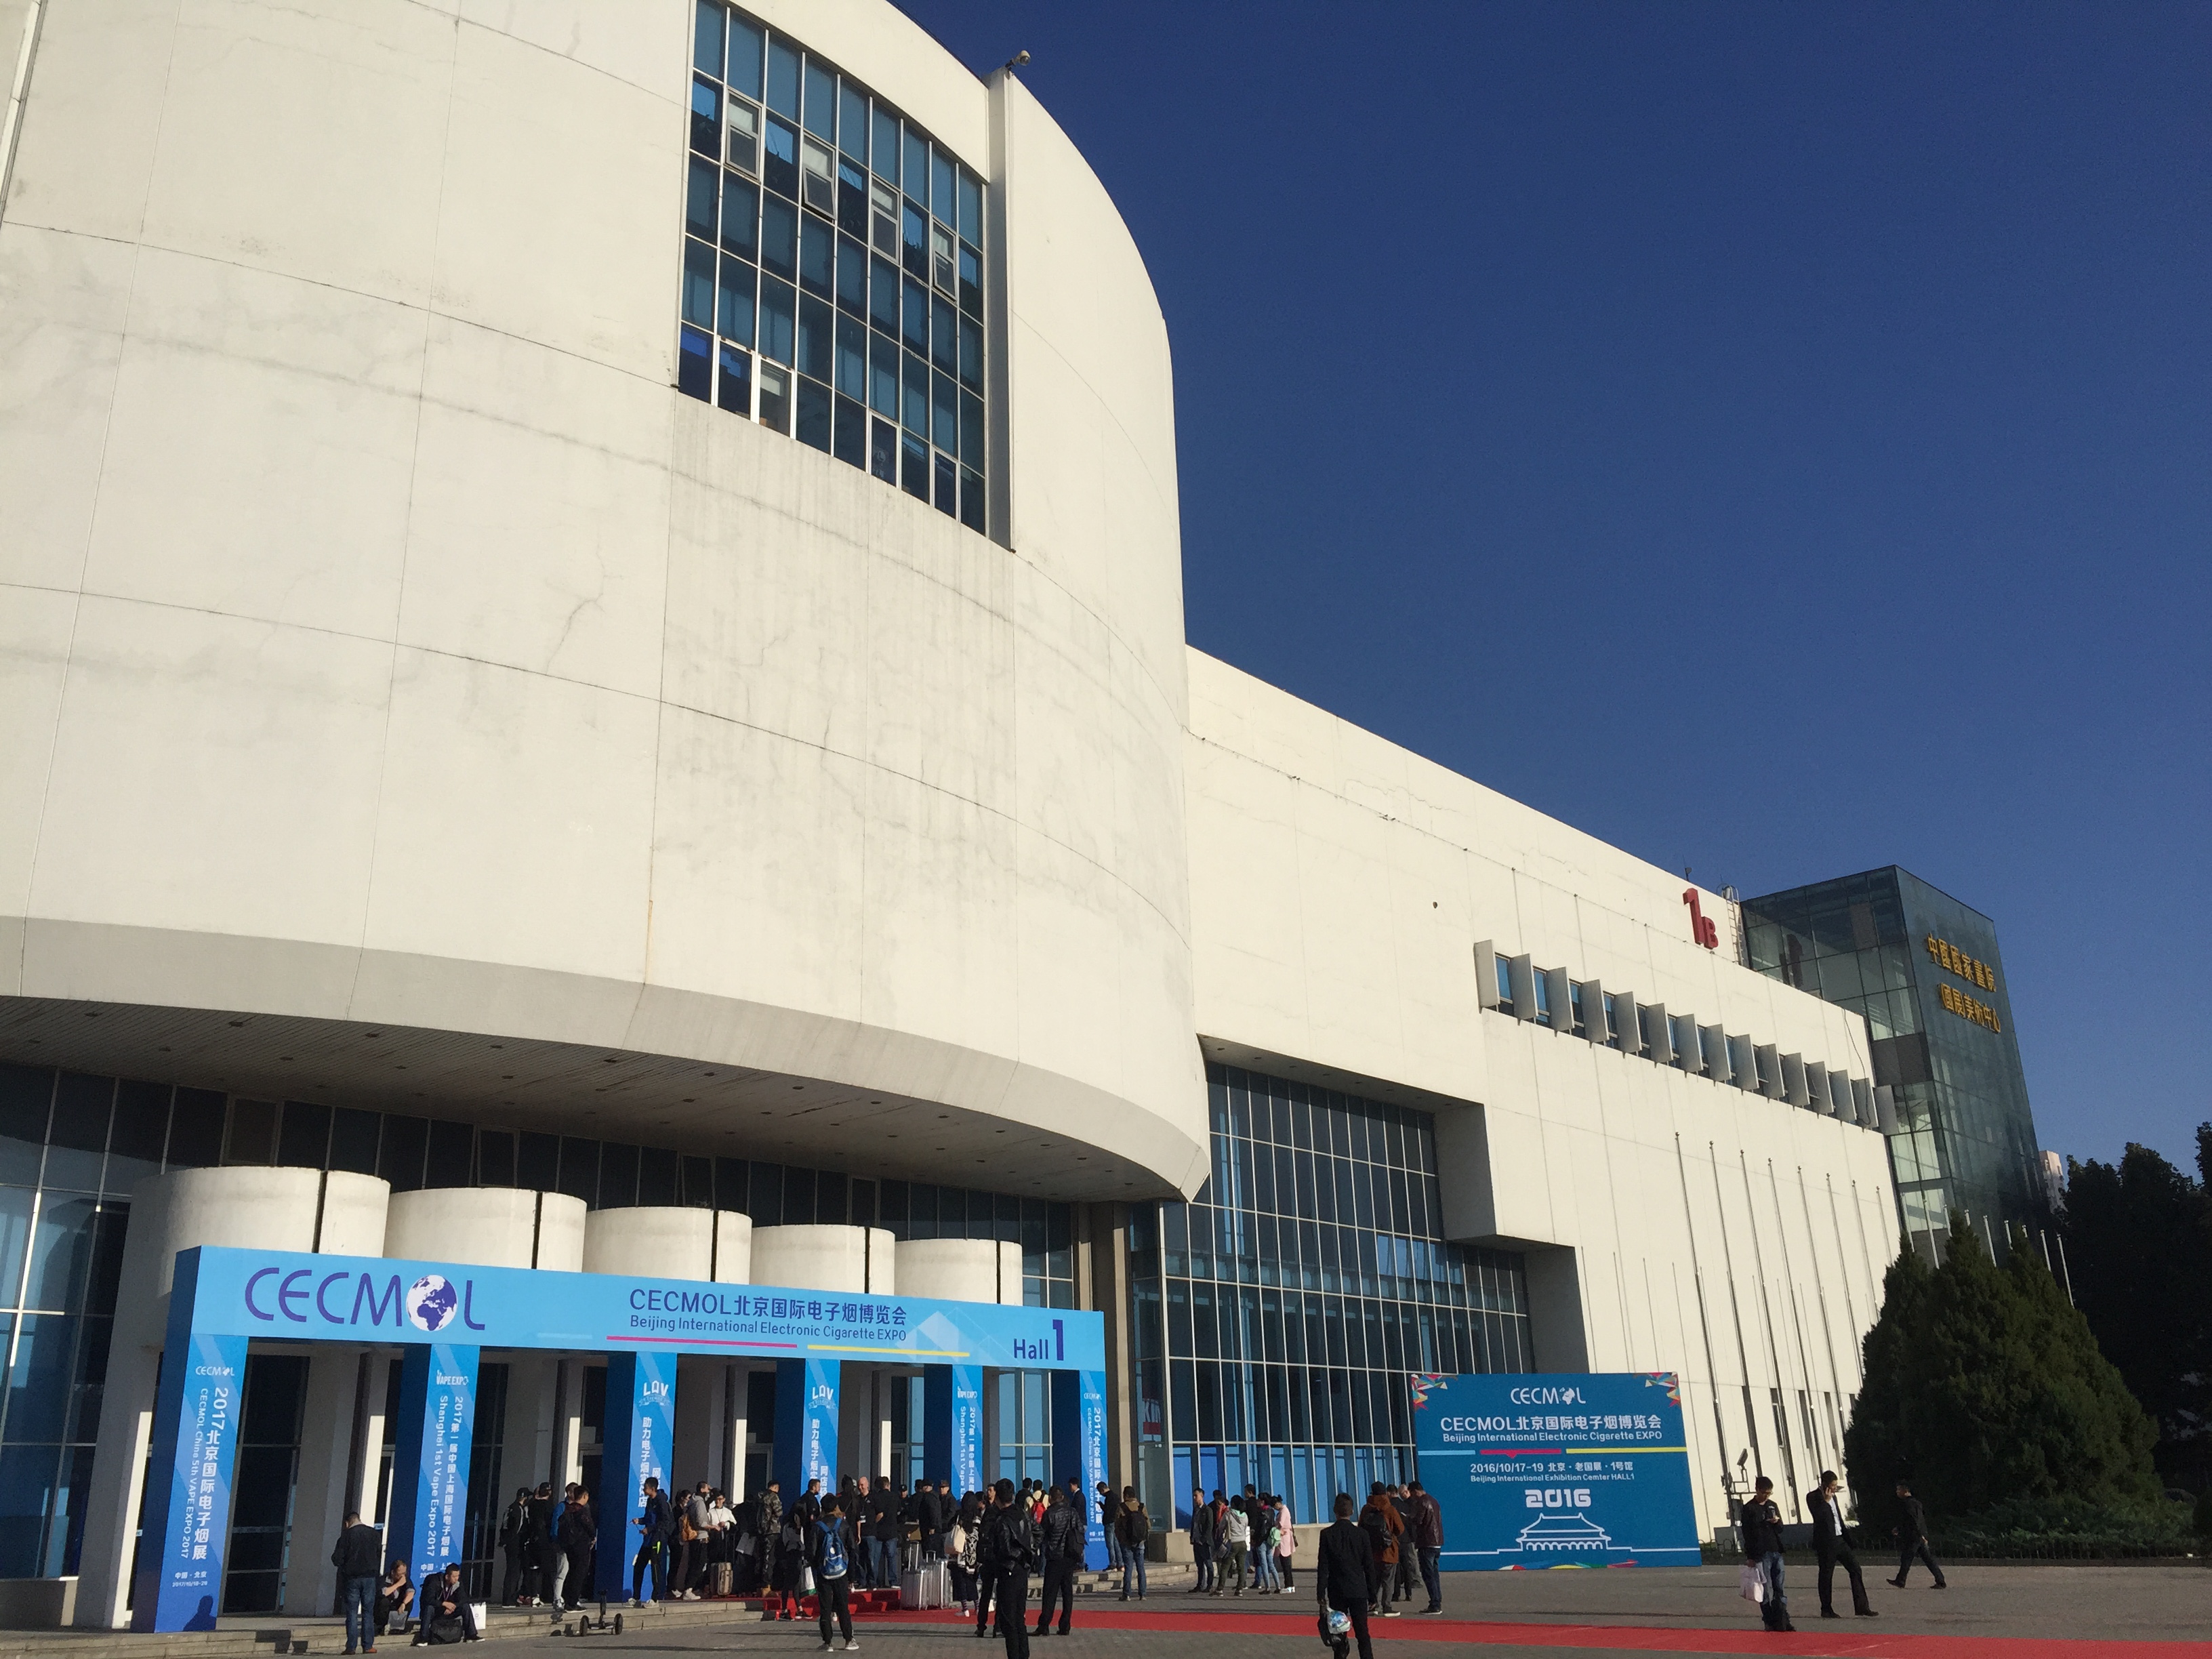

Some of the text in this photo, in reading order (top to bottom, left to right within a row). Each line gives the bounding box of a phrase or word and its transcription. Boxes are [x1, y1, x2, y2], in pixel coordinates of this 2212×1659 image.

[245, 1267, 485, 1332] CECMOL
[630, 1315, 907, 1341] Beijing International Electronic Cigarette EXPO
[1014, 1319, 1064, 1361] Hall 1
[1511, 1387, 1586, 1405] CECMOL
[1443, 1431, 1662, 1443] Beijing International Electronic Cigarette EXPO
[181, 1388, 209, 1559] CECMOL China 5th VAPE EXPO 2017
[426, 1395, 448, 1557] Shanghai 1st Vape Expo 2017
[1470, 1462, 1544, 1473] 2016/10/17-19
[1471, 1475, 1496, 1483] Beijing
[1497, 1474, 1544, 1482] International
[1545, 1473, 1582, 1481] Exhibition
[1525, 1488, 1591, 1508] 2016
